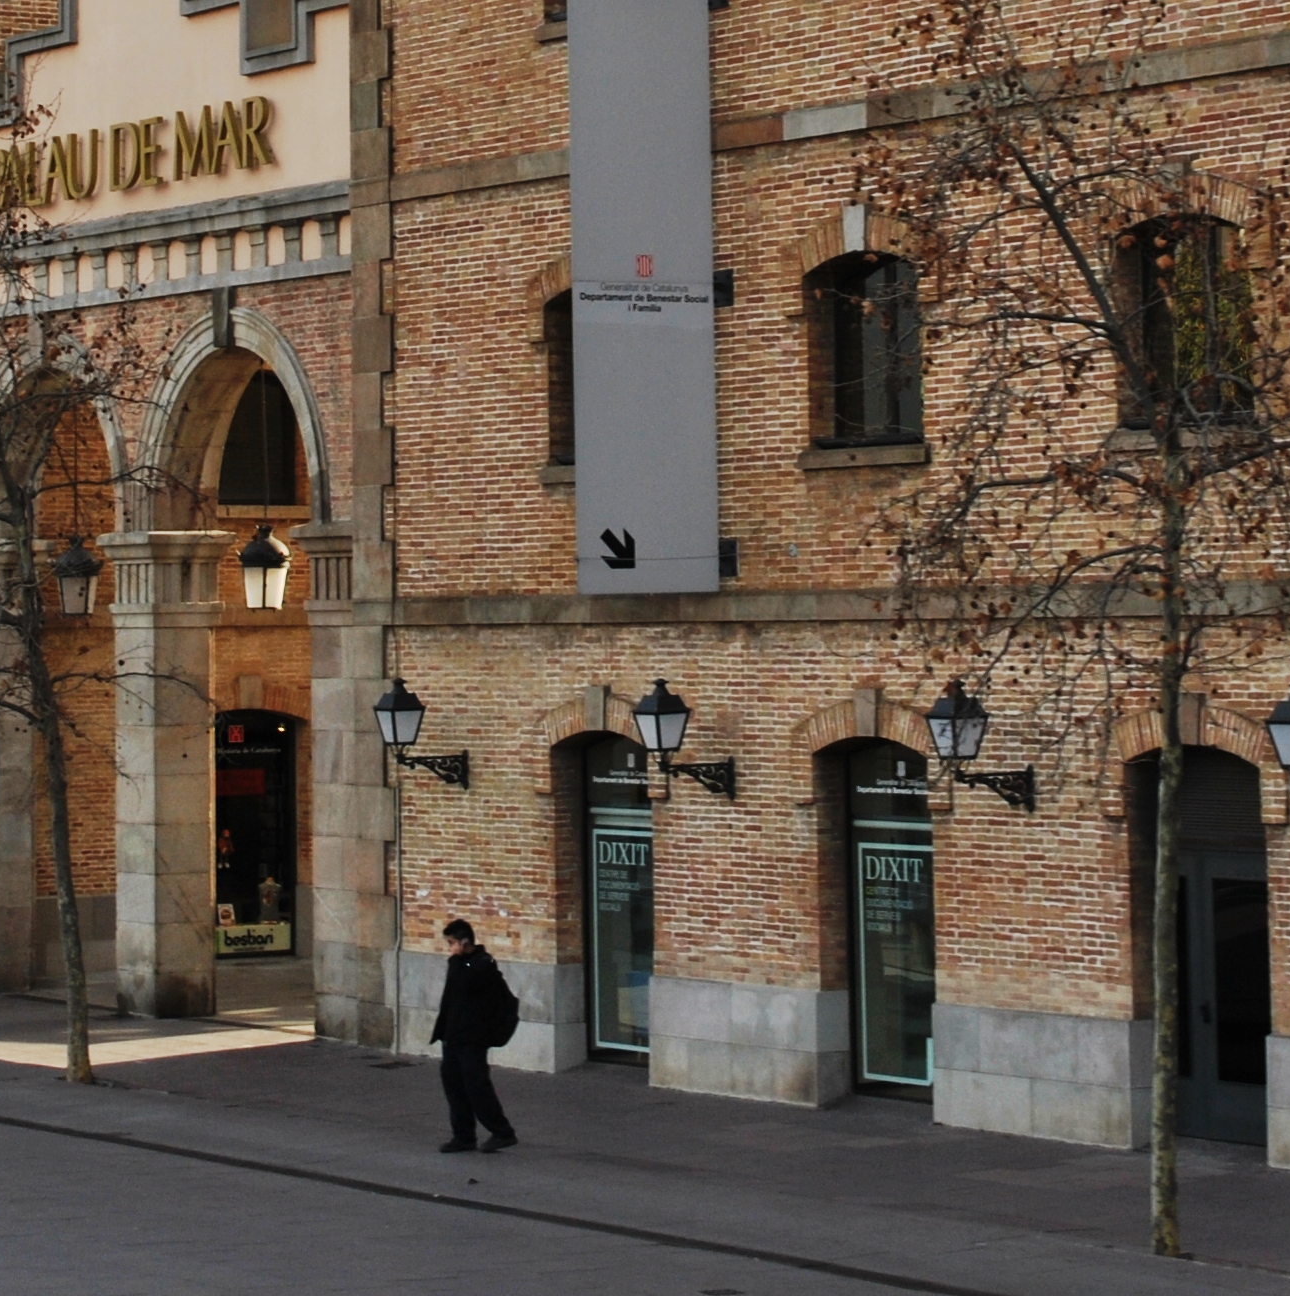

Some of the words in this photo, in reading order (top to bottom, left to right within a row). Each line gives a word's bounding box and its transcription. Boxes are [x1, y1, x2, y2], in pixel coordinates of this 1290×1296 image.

[109, 116, 165, 192] DE
[173, 95, 275, 181] MAR
[579, 292, 632, 301] Departament
[684, 294, 709, 303] Social
[598, 840, 649, 866] DIXIT
[865, 855, 924, 883] DIXIT
